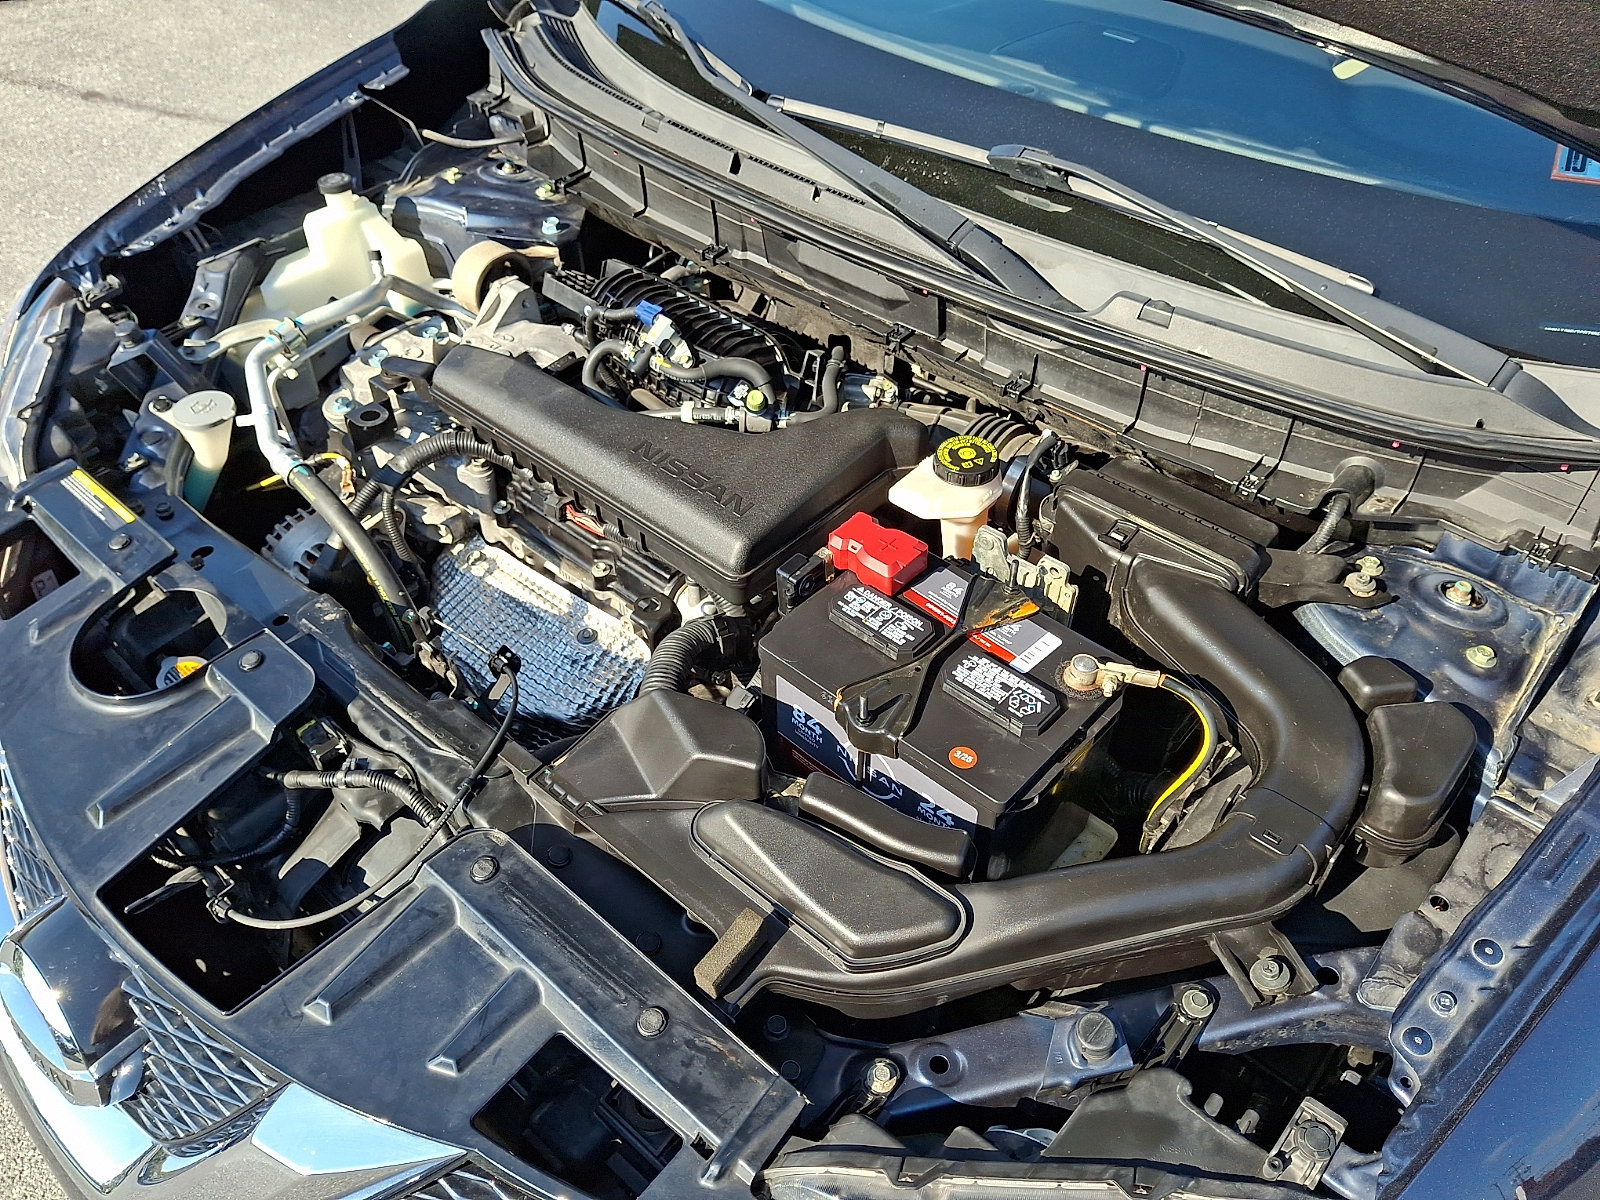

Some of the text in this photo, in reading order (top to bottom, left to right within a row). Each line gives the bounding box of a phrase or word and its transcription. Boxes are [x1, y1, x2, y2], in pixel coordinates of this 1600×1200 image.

[630, 440, 755, 517] NISSAN
[863, 589, 893, 610] DANGER
[896, 609, 923, 627] POISON
[791, 717, 823, 744] MONTH
[792, 704, 823, 735] 84
[953, 750, 974, 763] 3/25
[919, 791, 955, 826] 24
